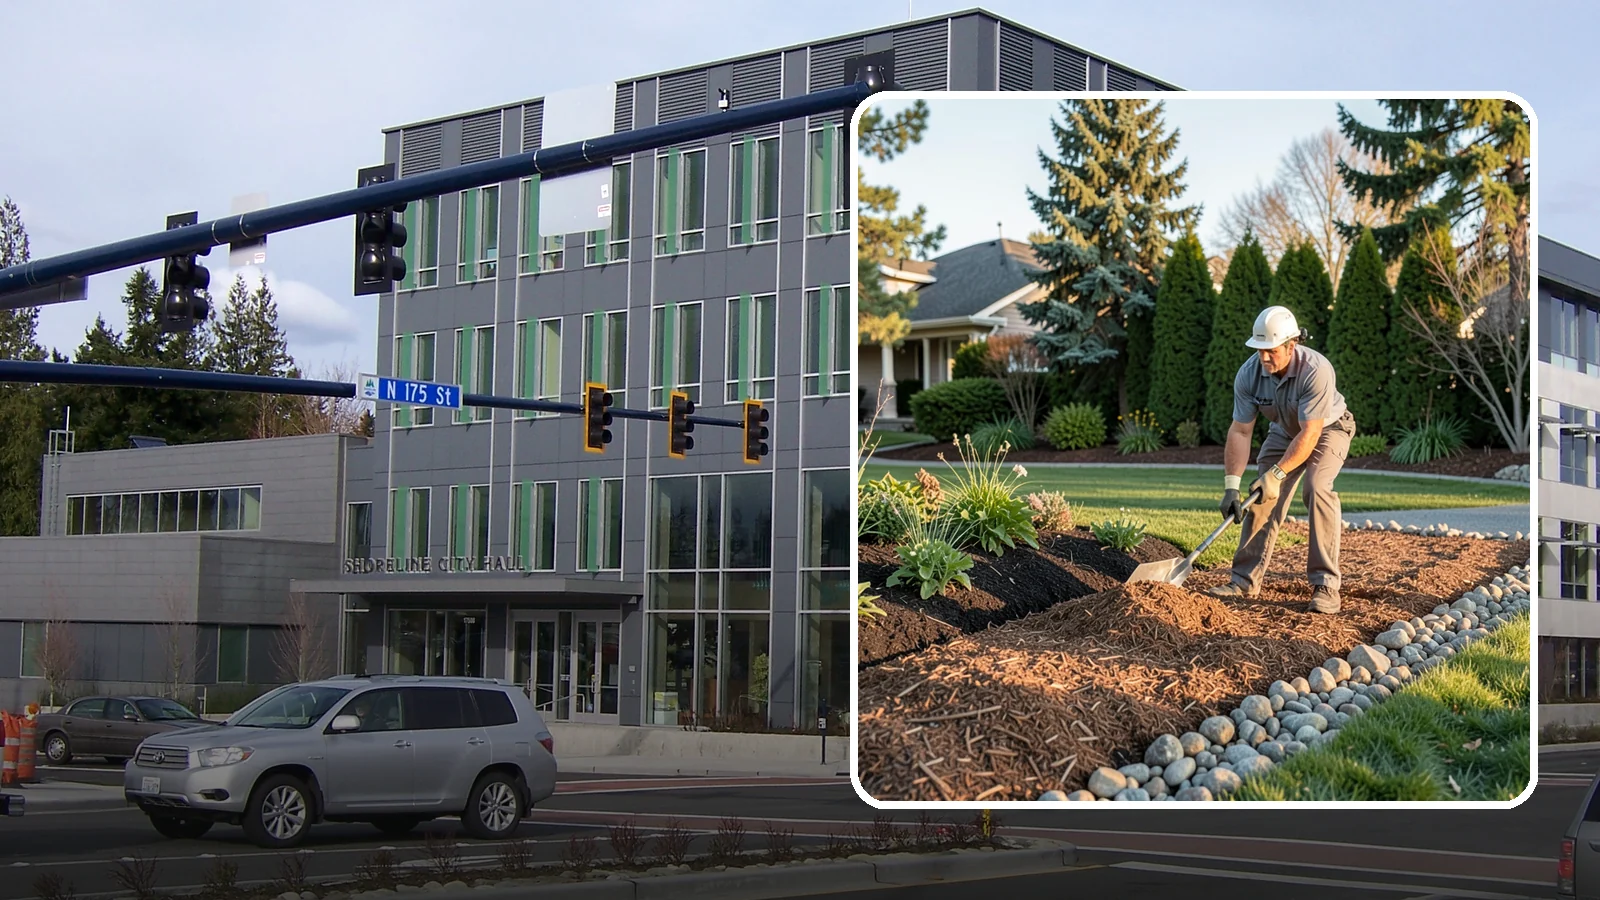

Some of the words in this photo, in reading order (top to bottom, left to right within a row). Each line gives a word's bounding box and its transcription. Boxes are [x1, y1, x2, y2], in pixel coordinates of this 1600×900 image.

[387, 380, 396, 400] N
[405, 382, 428, 403] 175
[436, 386, 452, 406] St
[343, 557, 432, 574] SHORELINE
[439, 556, 476, 572] CITY
[484, 555, 526, 572] HALL
